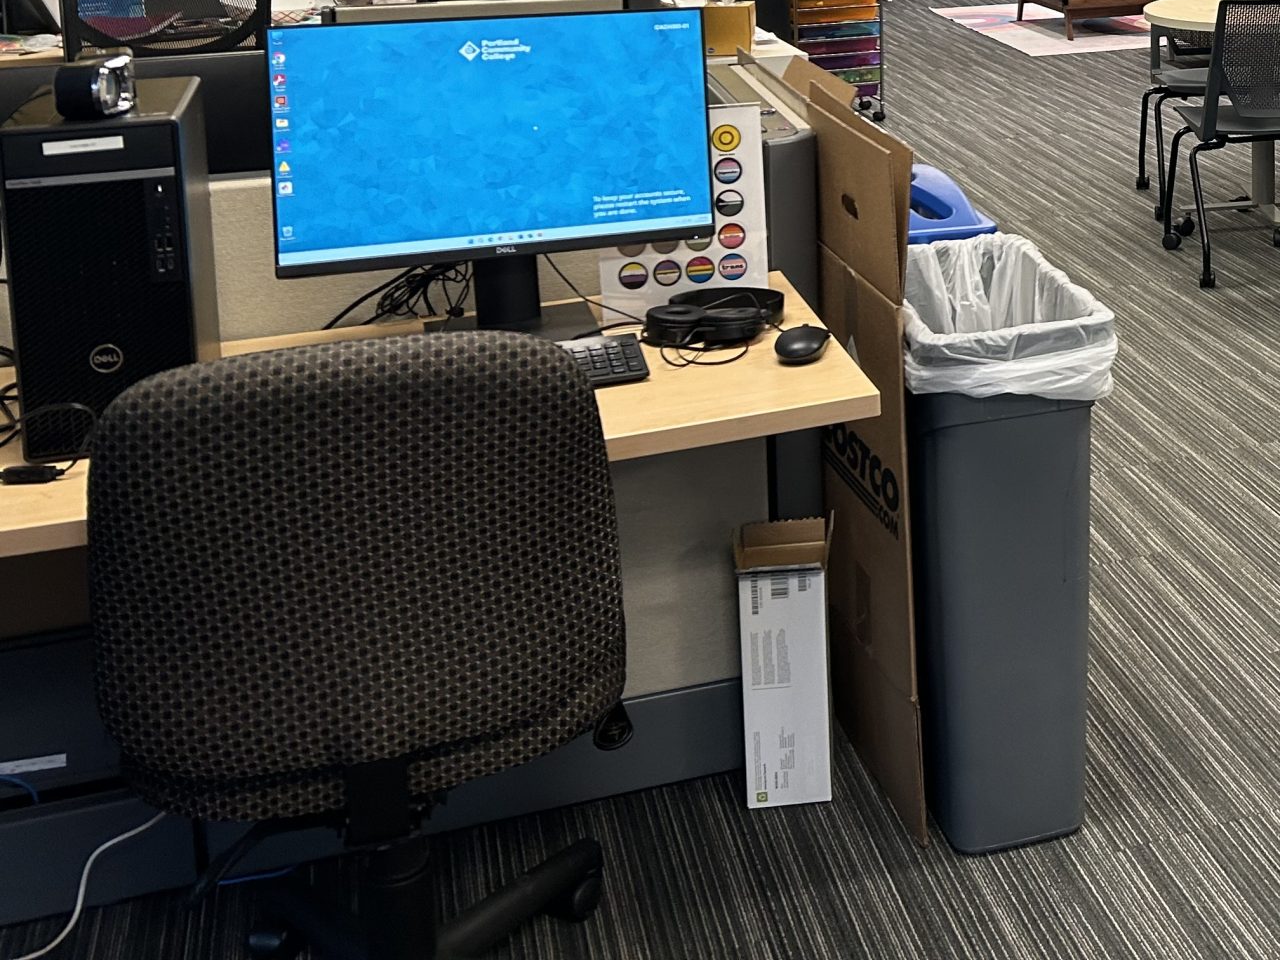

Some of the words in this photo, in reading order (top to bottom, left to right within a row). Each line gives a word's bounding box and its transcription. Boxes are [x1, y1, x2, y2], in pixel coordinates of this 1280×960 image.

[481, 38, 520, 47] Portland
[481, 44, 532, 53] Community
[481, 52, 516, 61] College
[618, 193, 634, 201] your
[634, 191, 663, 199] accounts
[593, 203, 615, 211] please
[650, 197, 673, 206] system
[593, 211, 607, 219] you
[496, 245, 517, 254] DELL
[721, 263, 745, 271] trans
[94, 353, 120, 363] DELL
